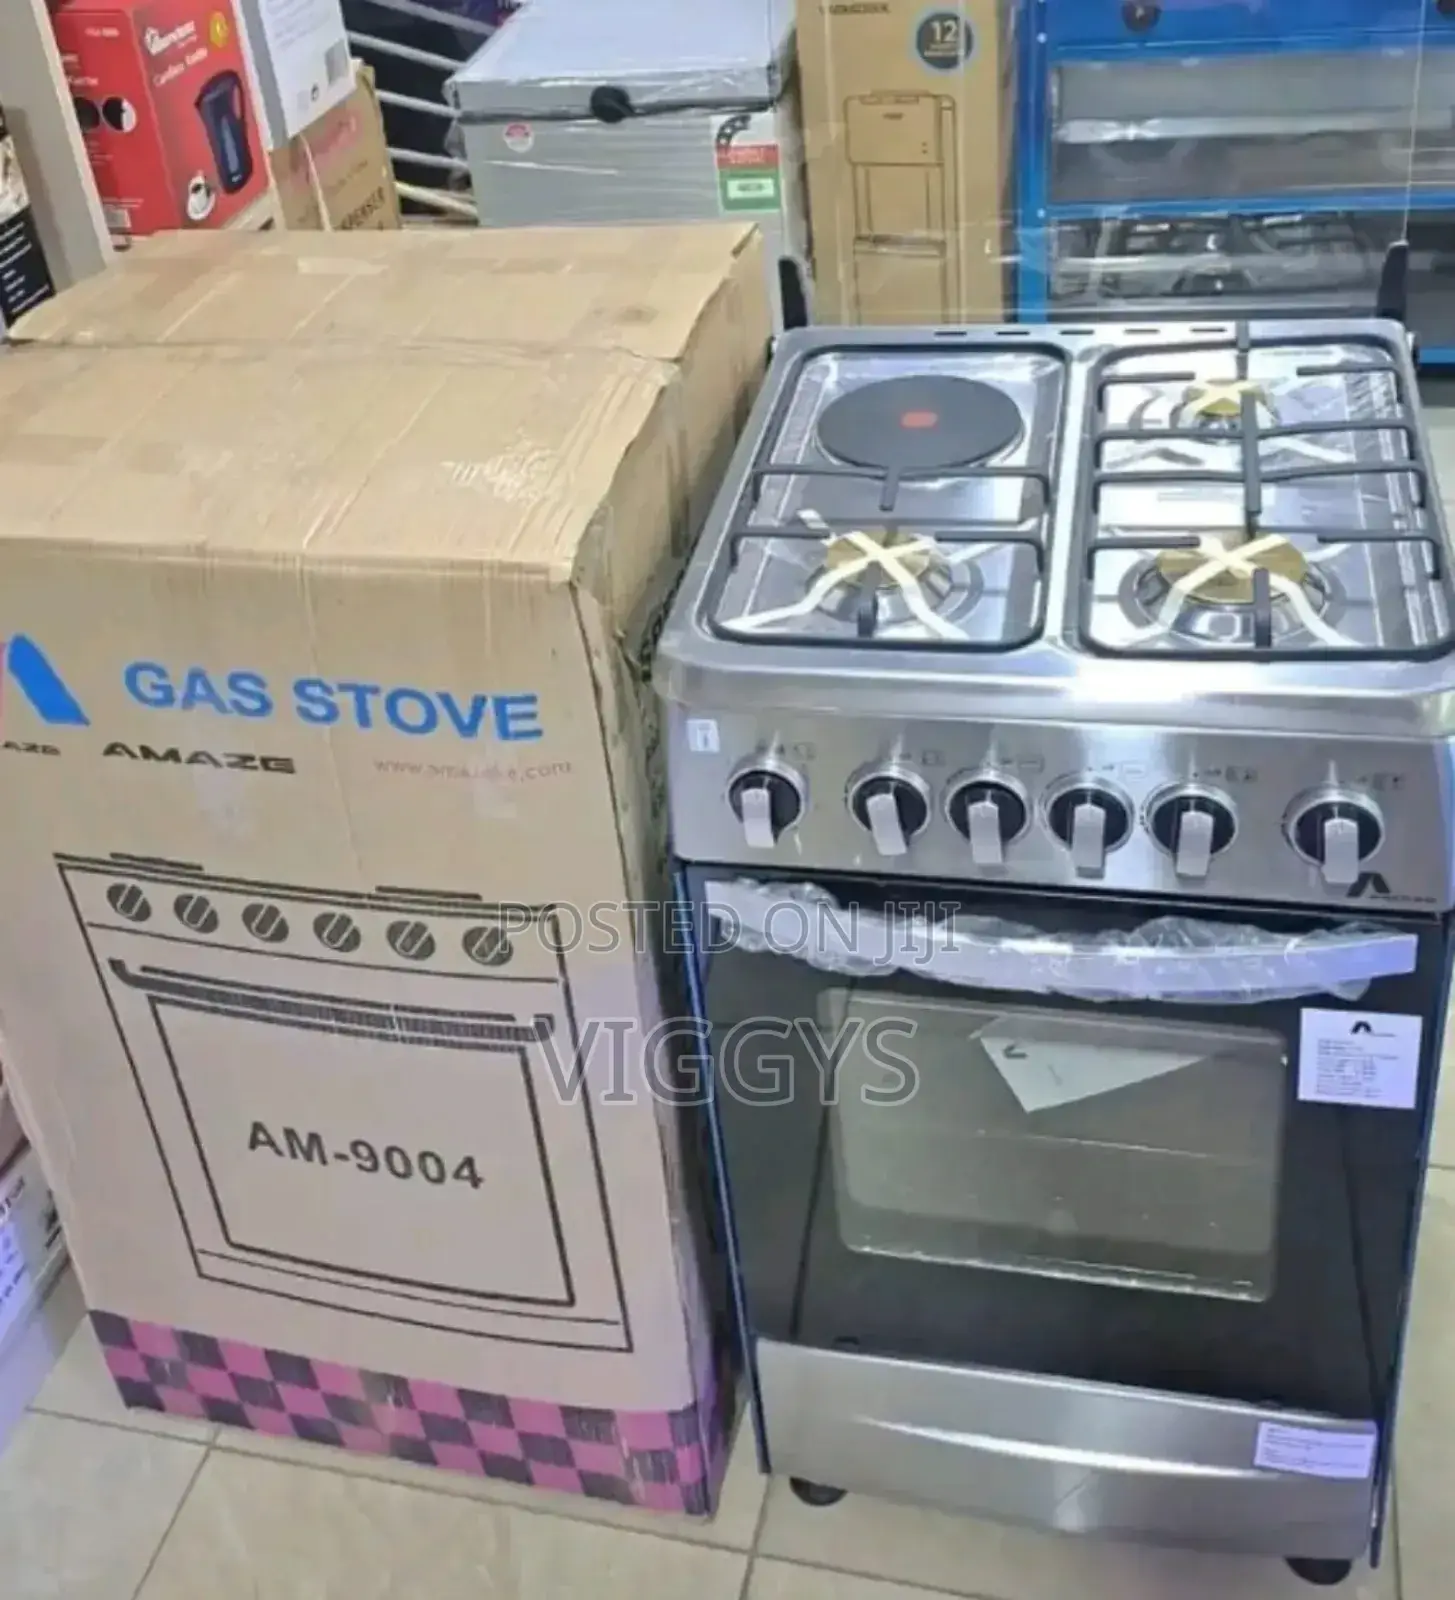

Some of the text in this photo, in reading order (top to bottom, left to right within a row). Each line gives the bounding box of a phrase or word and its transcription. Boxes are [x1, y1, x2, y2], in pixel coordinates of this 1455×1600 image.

[932, 19, 958, 42] 12
[124, 661, 543, 741] GAS STOVE
[102, 742, 297, 775] AMAZE
[248, 1120, 484, 1190] AM-9004
